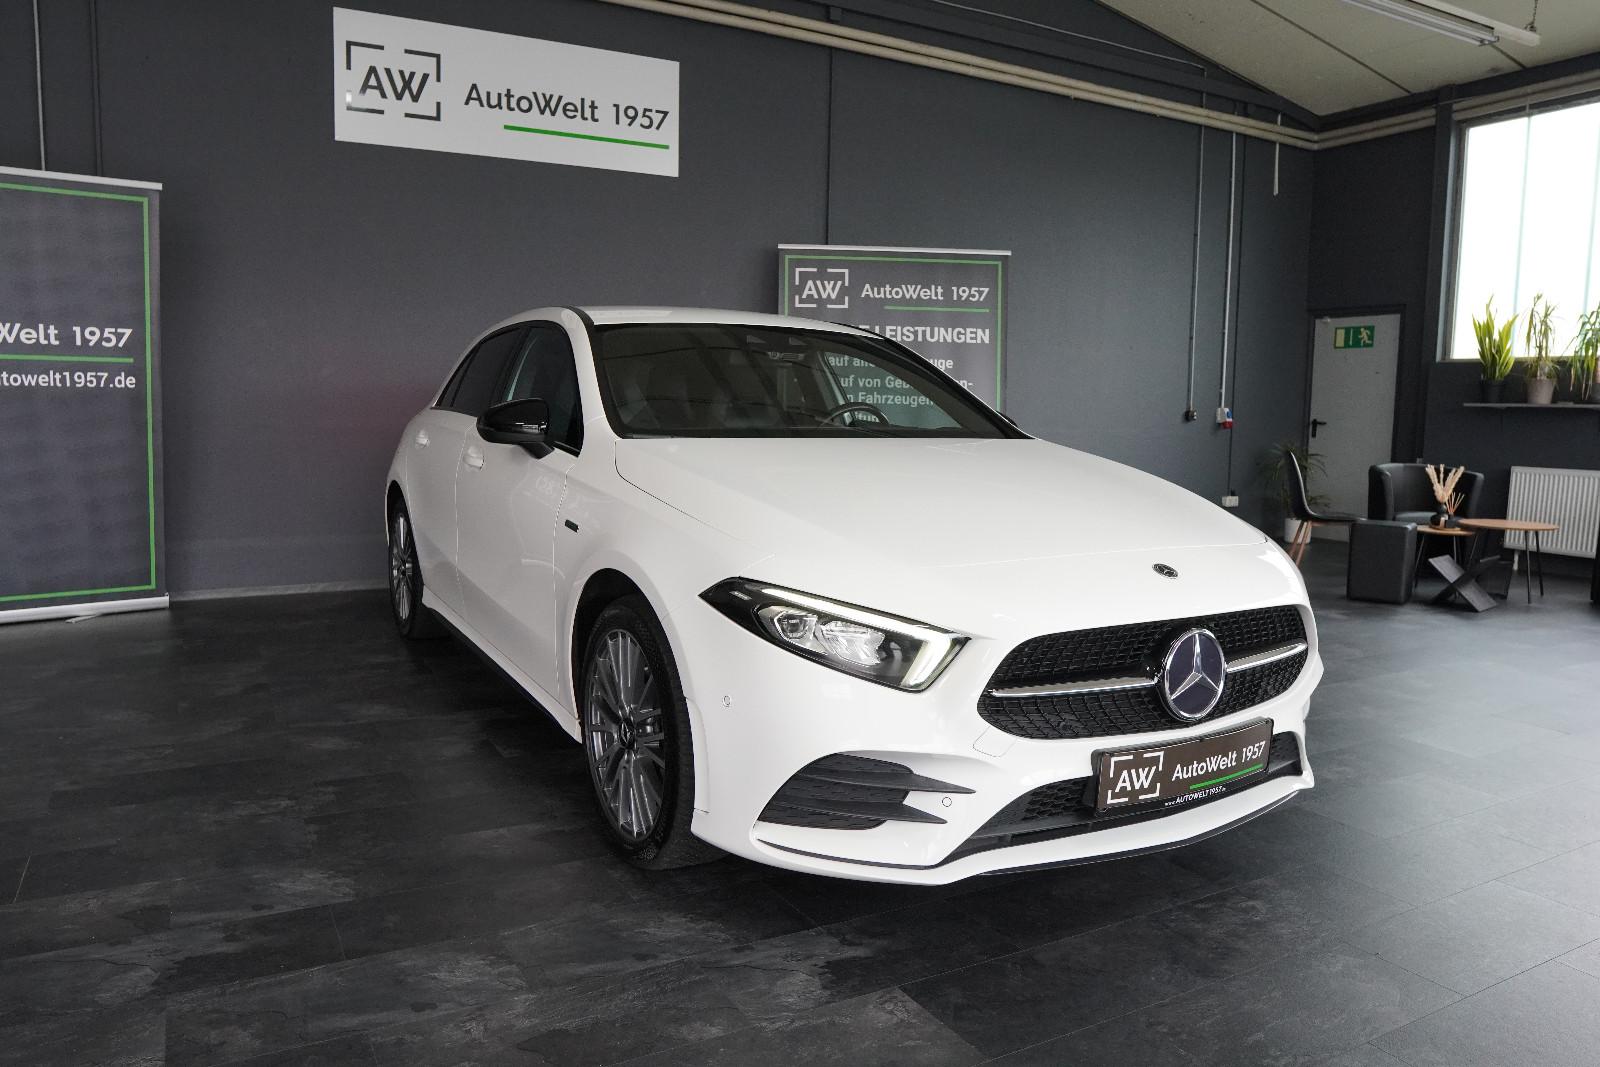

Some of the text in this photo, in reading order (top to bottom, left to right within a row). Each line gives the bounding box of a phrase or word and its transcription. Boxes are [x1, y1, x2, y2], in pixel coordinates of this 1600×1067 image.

[359, 65, 430, 103] AW
[464, 83, 670, 131] AutoWelt 1957
[801, 279, 842, 299] AW
[861, 283, 990, 302] AutoWelt 1957
[72, 326, 133, 348] 1957
[0, 370, 136, 388] towelt1957.de
[838, 374, 855, 387] uf
[858, 377, 881, 388] von
[1171, 740, 1266, 781] AutoWelt 1957
[1115, 766, 1157, 793] AW
